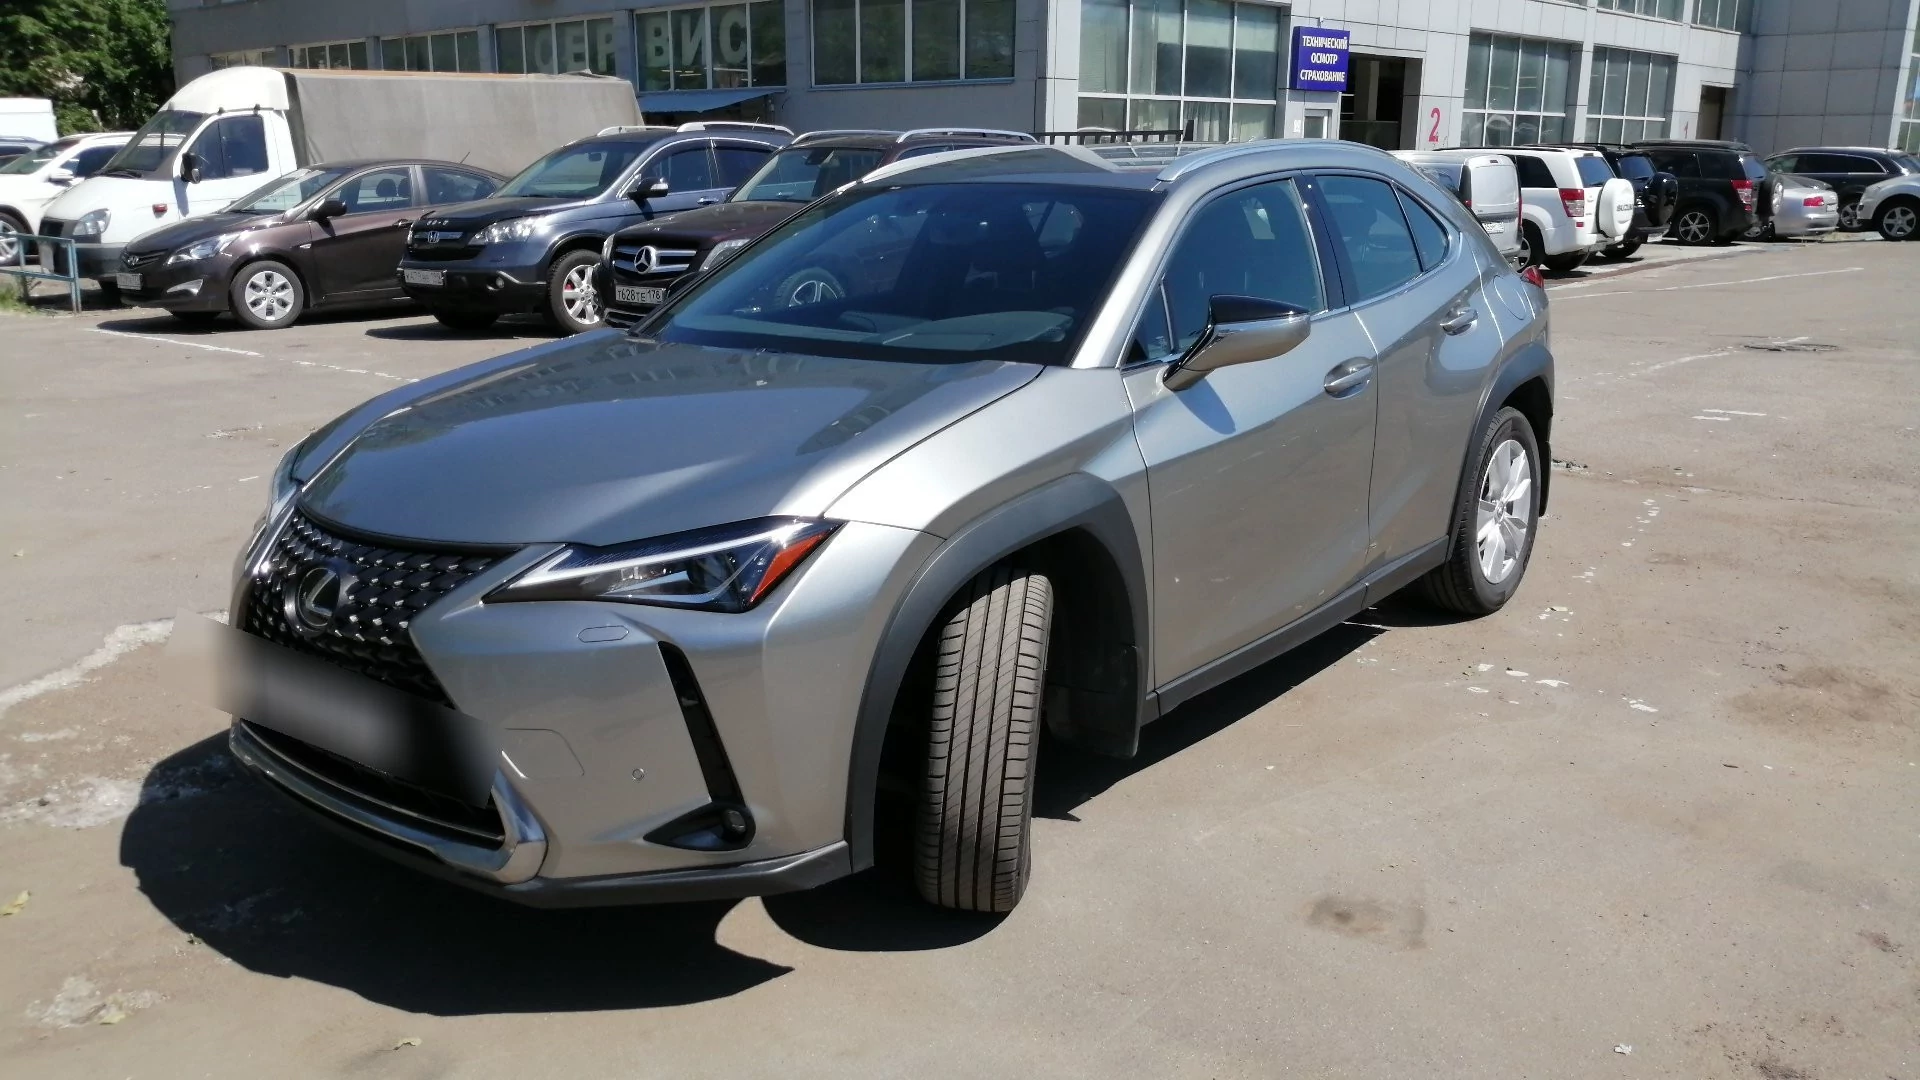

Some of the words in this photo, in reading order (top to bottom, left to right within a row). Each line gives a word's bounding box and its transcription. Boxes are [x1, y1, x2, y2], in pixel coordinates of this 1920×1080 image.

[1302, 36, 1348, 50] ТЕХНИЧЕСКИЙ
[1310, 52, 1338, 65] ОСМОТР
[1300, 69, 1345, 83] СТРАХОВАНИЕ
[1428, 107, 1440, 142] 2
